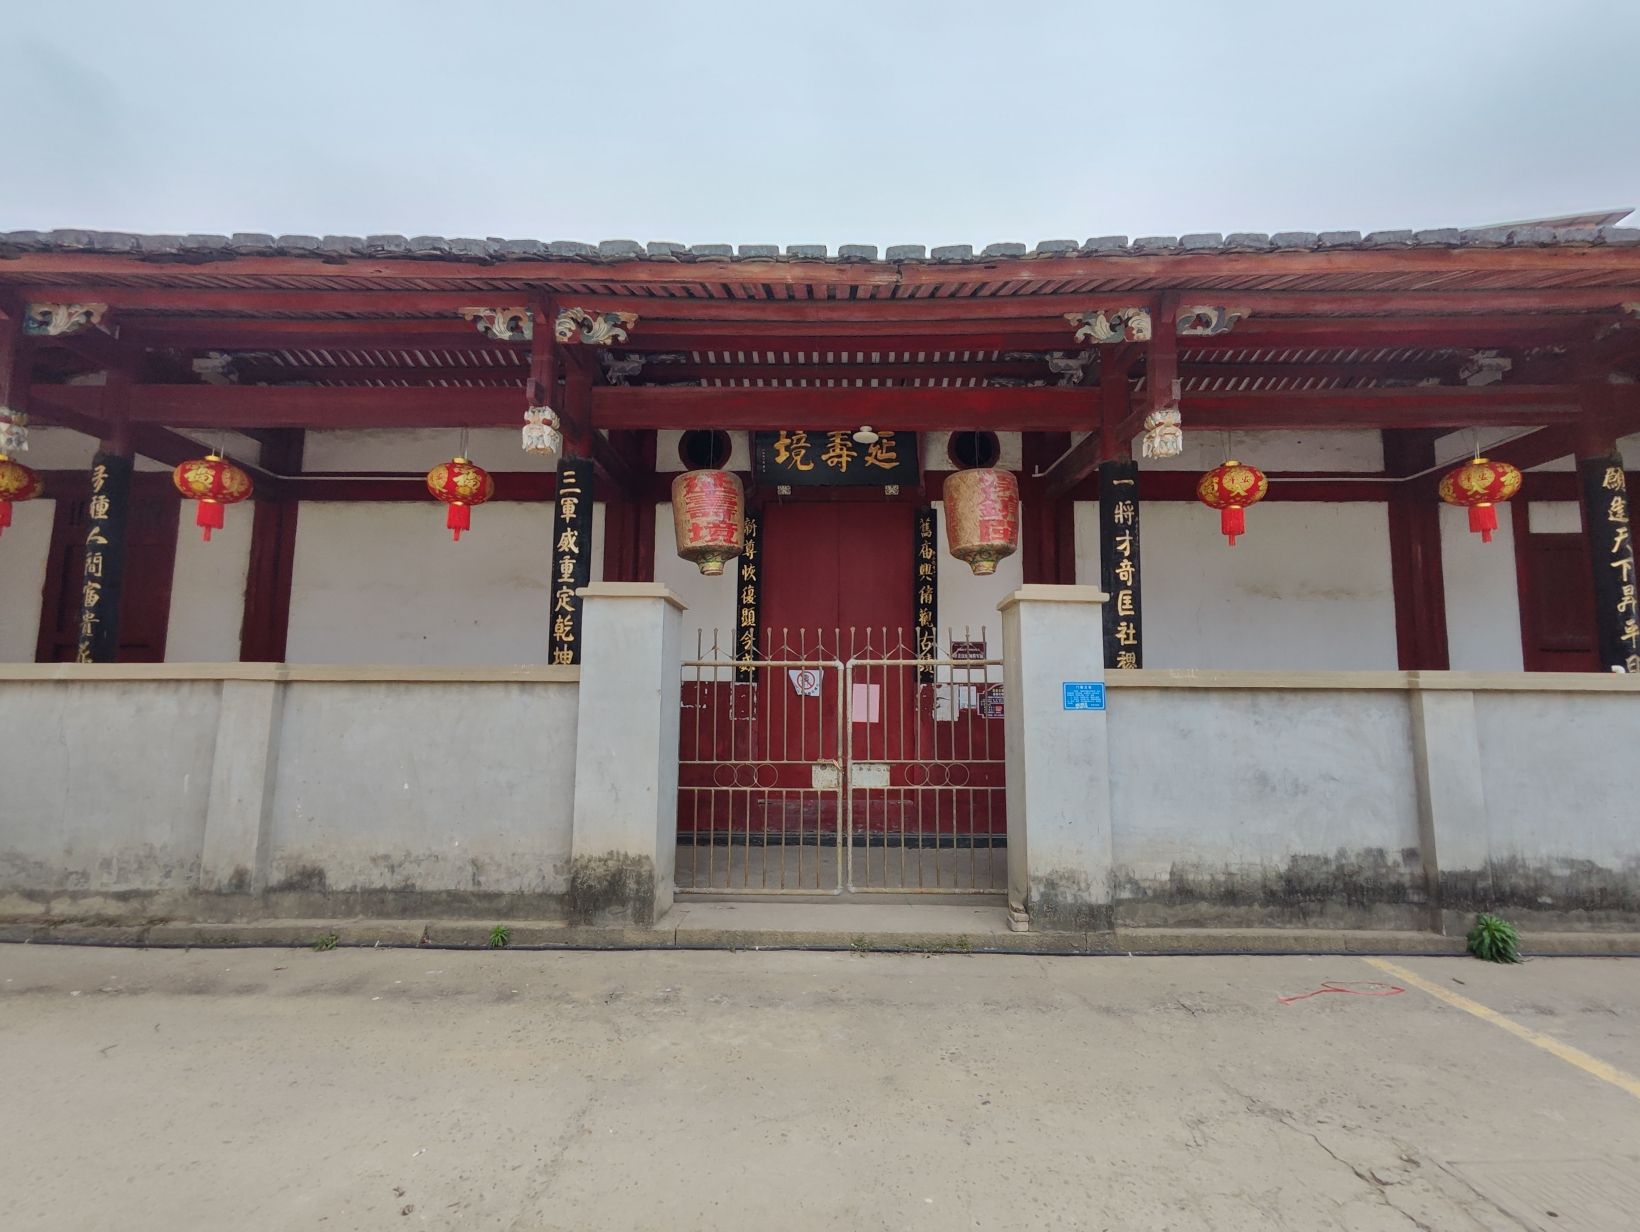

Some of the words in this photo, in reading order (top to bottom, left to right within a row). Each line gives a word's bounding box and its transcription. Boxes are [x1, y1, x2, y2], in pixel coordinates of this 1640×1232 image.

[553, 471, 582, 665] 三軍威重定乾坤
[1112, 479, 1138, 669] 一將才奇匡社稷
